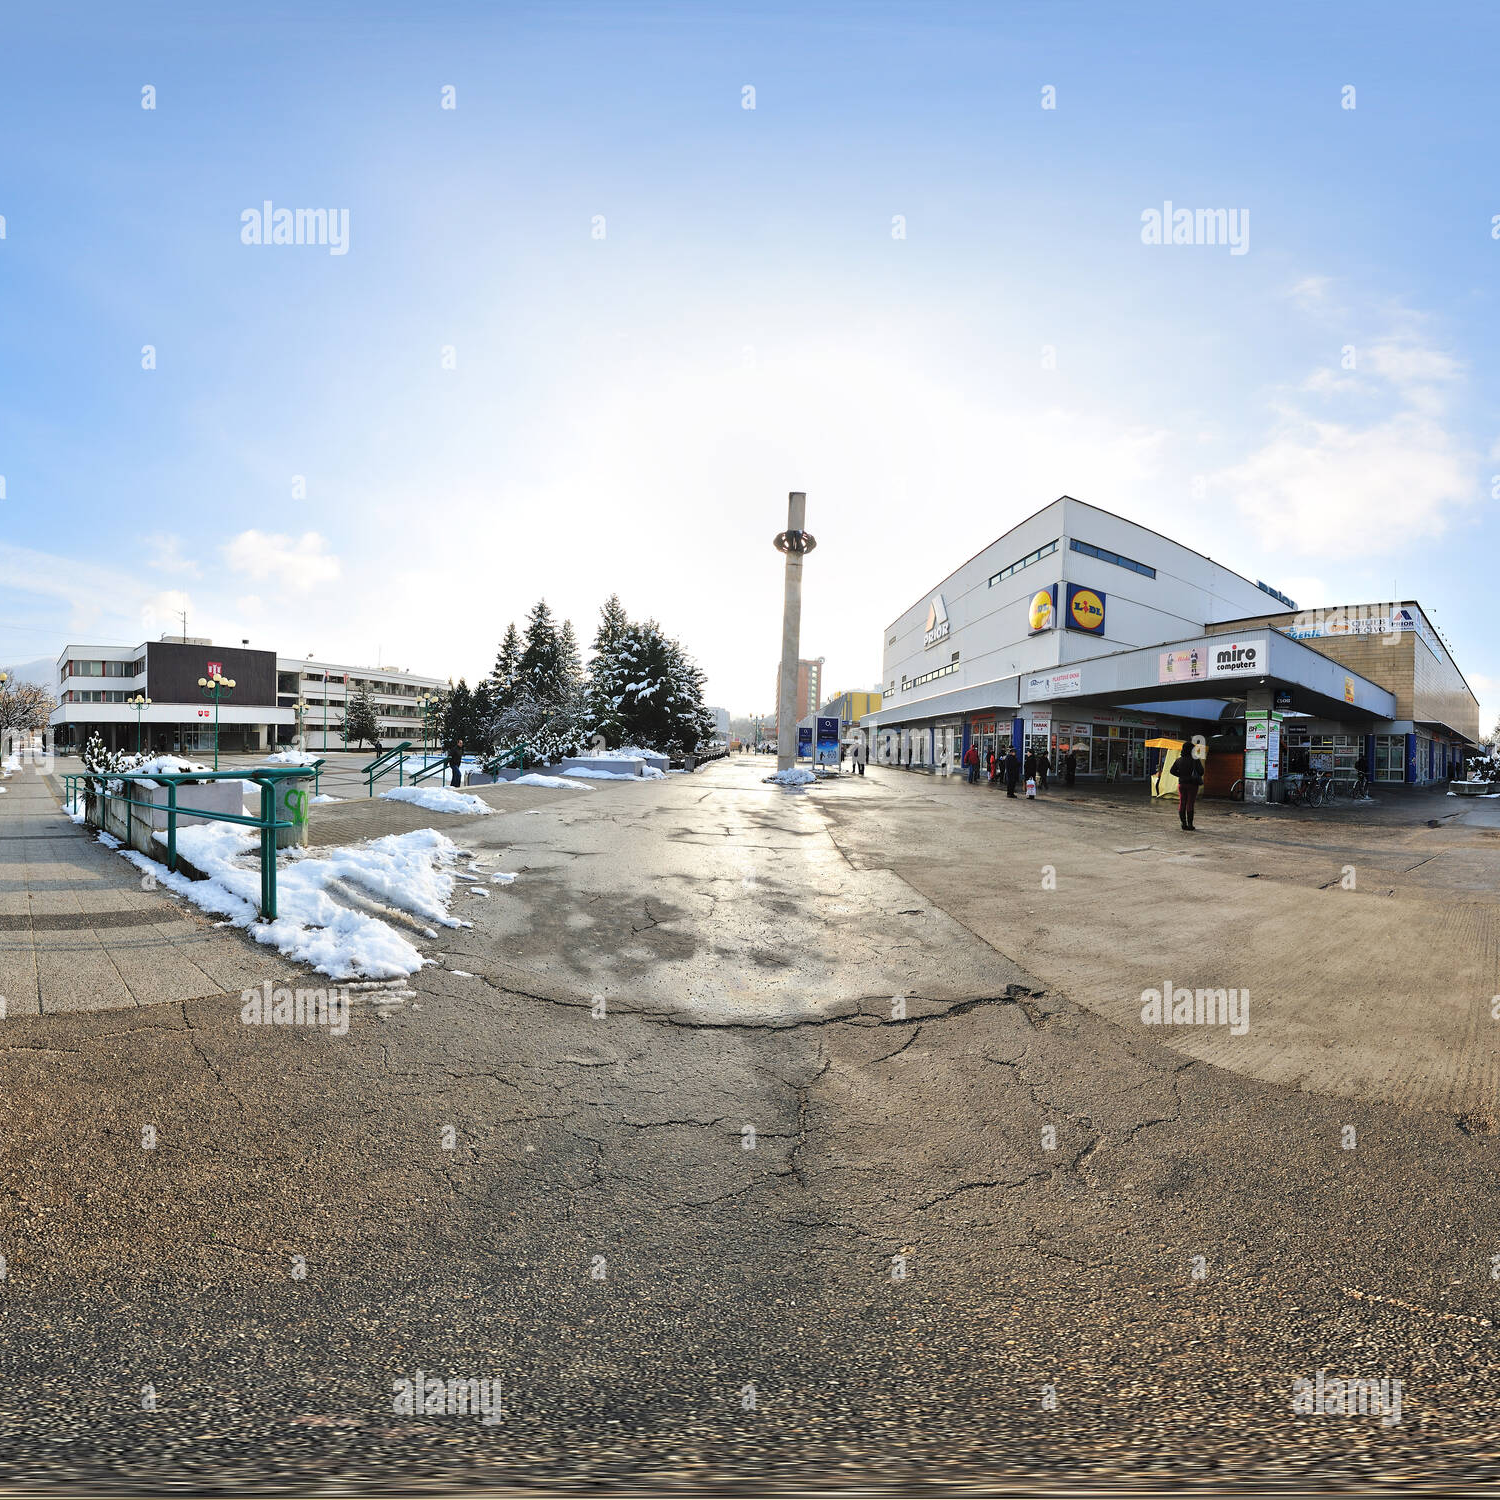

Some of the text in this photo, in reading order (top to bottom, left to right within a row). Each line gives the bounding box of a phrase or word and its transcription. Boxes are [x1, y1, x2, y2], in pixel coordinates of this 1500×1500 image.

[924, 622, 950, 647] PRIOR
[1217, 644, 1256, 663] miro
[1217, 661, 1256, 671] computers
